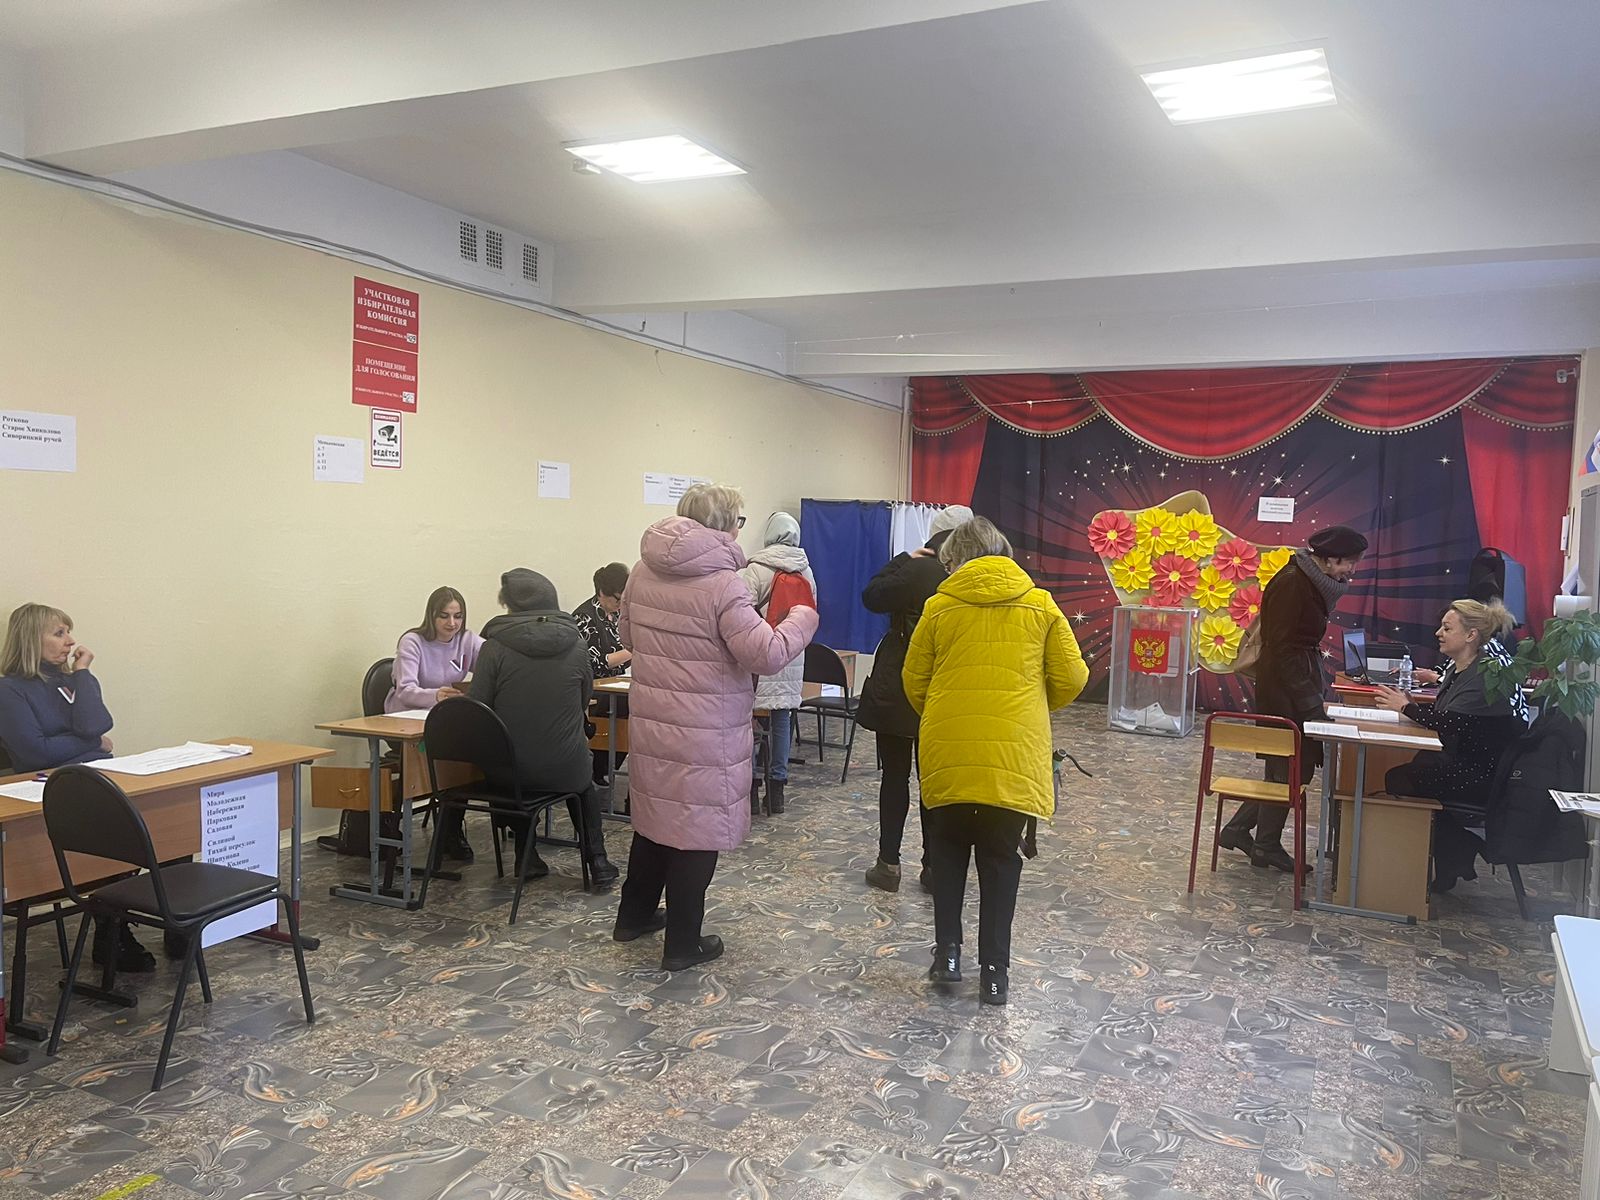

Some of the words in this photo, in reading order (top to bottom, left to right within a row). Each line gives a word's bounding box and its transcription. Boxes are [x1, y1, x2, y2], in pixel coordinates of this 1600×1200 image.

[364, 287, 410, 306] УЧАСТКОВАЯ
[357, 296, 417, 318] ИЗБИРАТЕЛЬНАЯ
[367, 310, 408, 326] КОМИССИЯ
[365, 357, 407, 372] ПОМЕЩЕНИЕ
[355, 364, 369, 374] ДЛЯ
[369, 367, 416, 382] ГОЛОСОВАНИЯ
[207, 790, 225, 799] Мира
[207, 795, 246, 807] Молодежная
[207, 804, 245, 817] Набережная
[207, 814, 238, 826] Парковая
[206, 823, 233, 835] Садовая
[207, 846, 227, 856] Тихий
[228, 840, 256, 851] переулок
